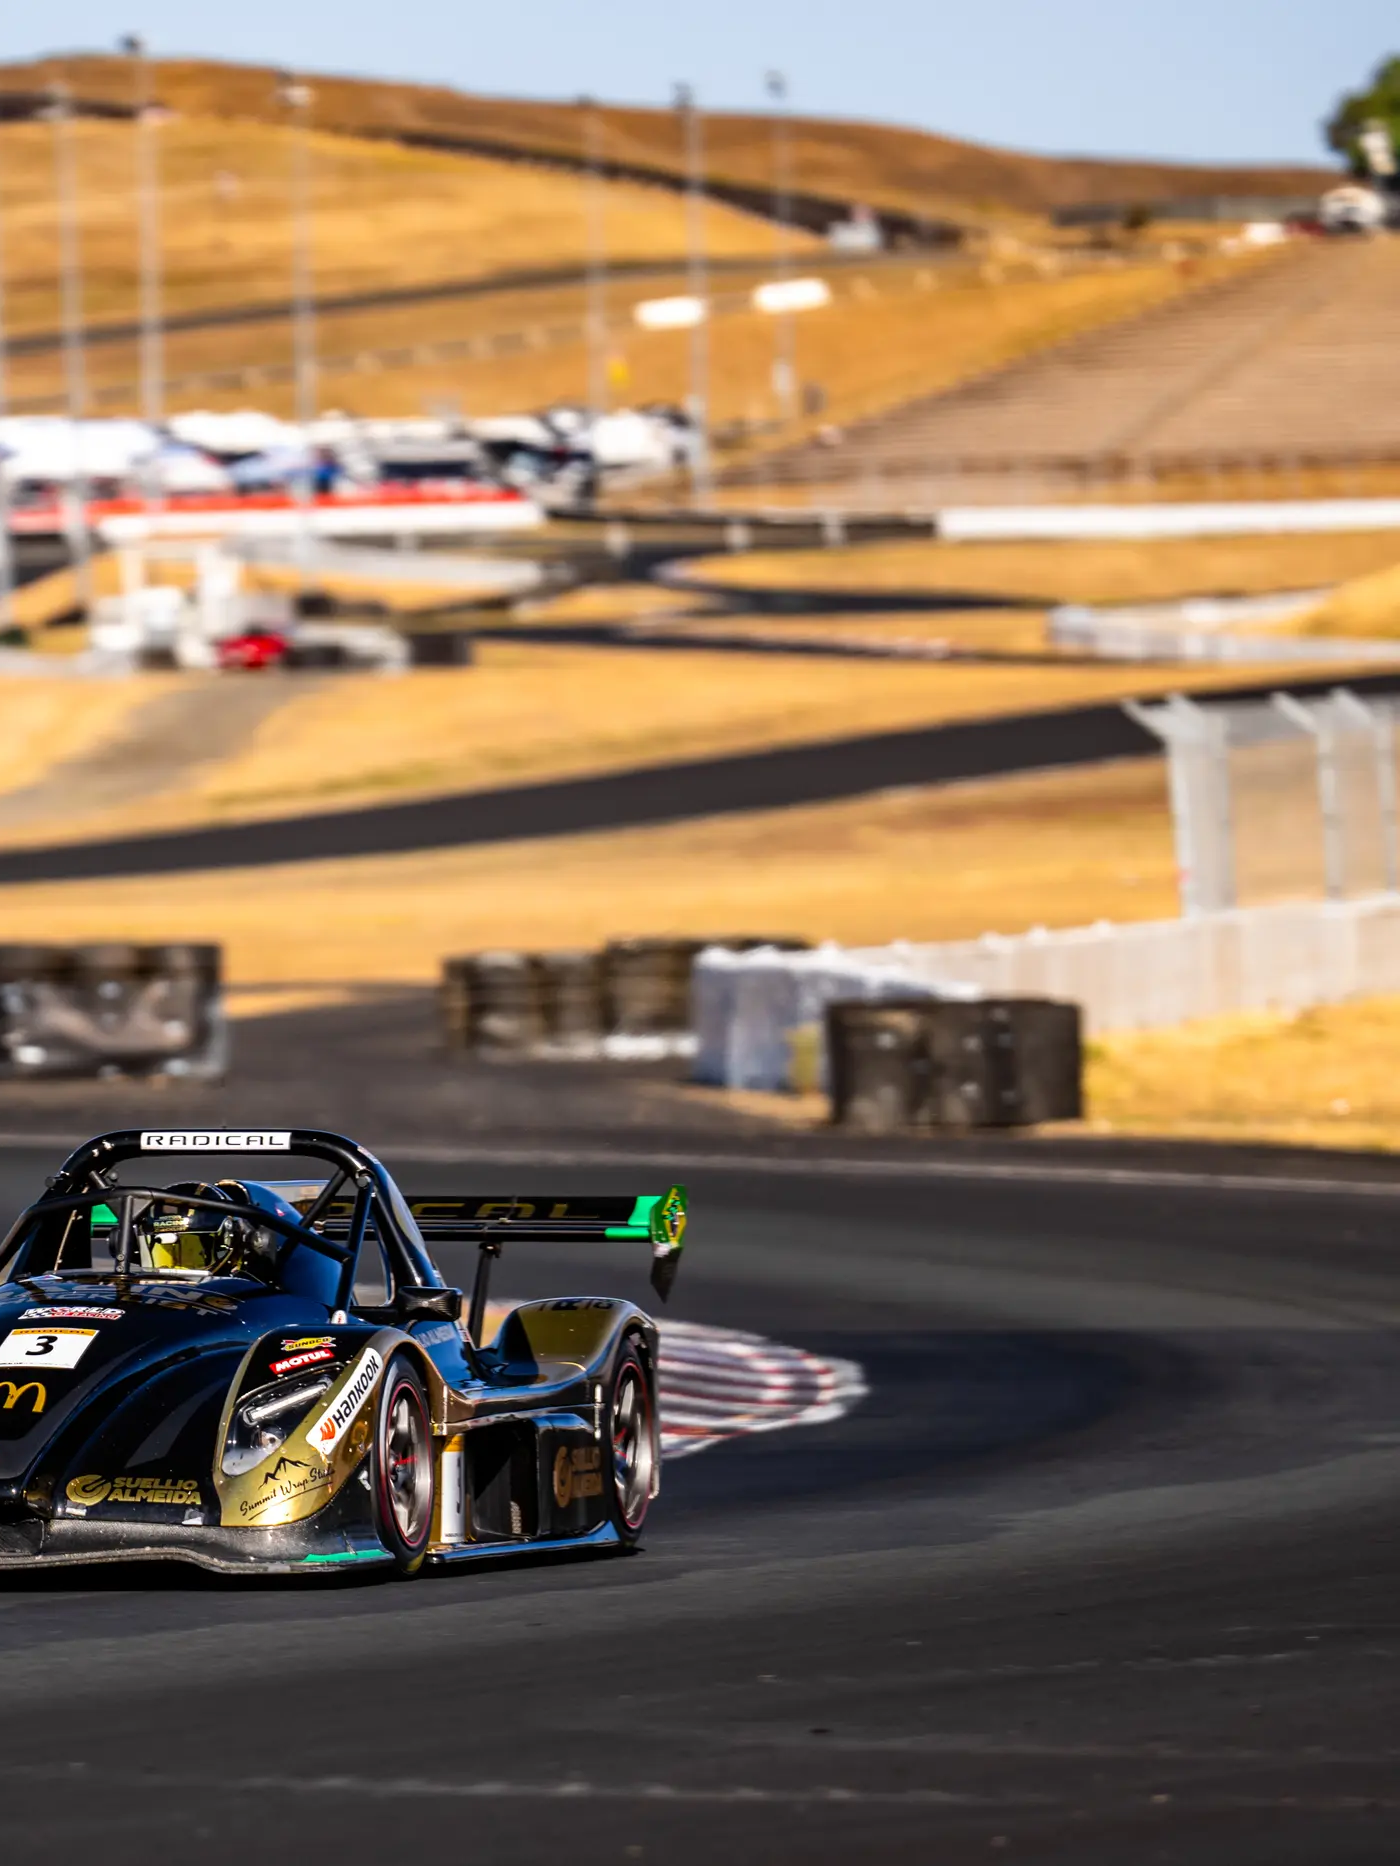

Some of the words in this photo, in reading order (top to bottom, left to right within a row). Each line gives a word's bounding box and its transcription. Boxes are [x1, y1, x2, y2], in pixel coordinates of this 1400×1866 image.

[146, 1135, 284, 1146] RADICAL
[25, 1335, 58, 1356] 3
[288, 1338, 330, 1350] SUNOCO
[275, 1350, 330, 1372] MOTUL
[113, 1477, 198, 1490] SUELLIO
[108, 1489, 202, 1505] ALMEIDA
[240, 1488, 277, 1516] Summit
[280, 1479, 309, 1498] Wrap
